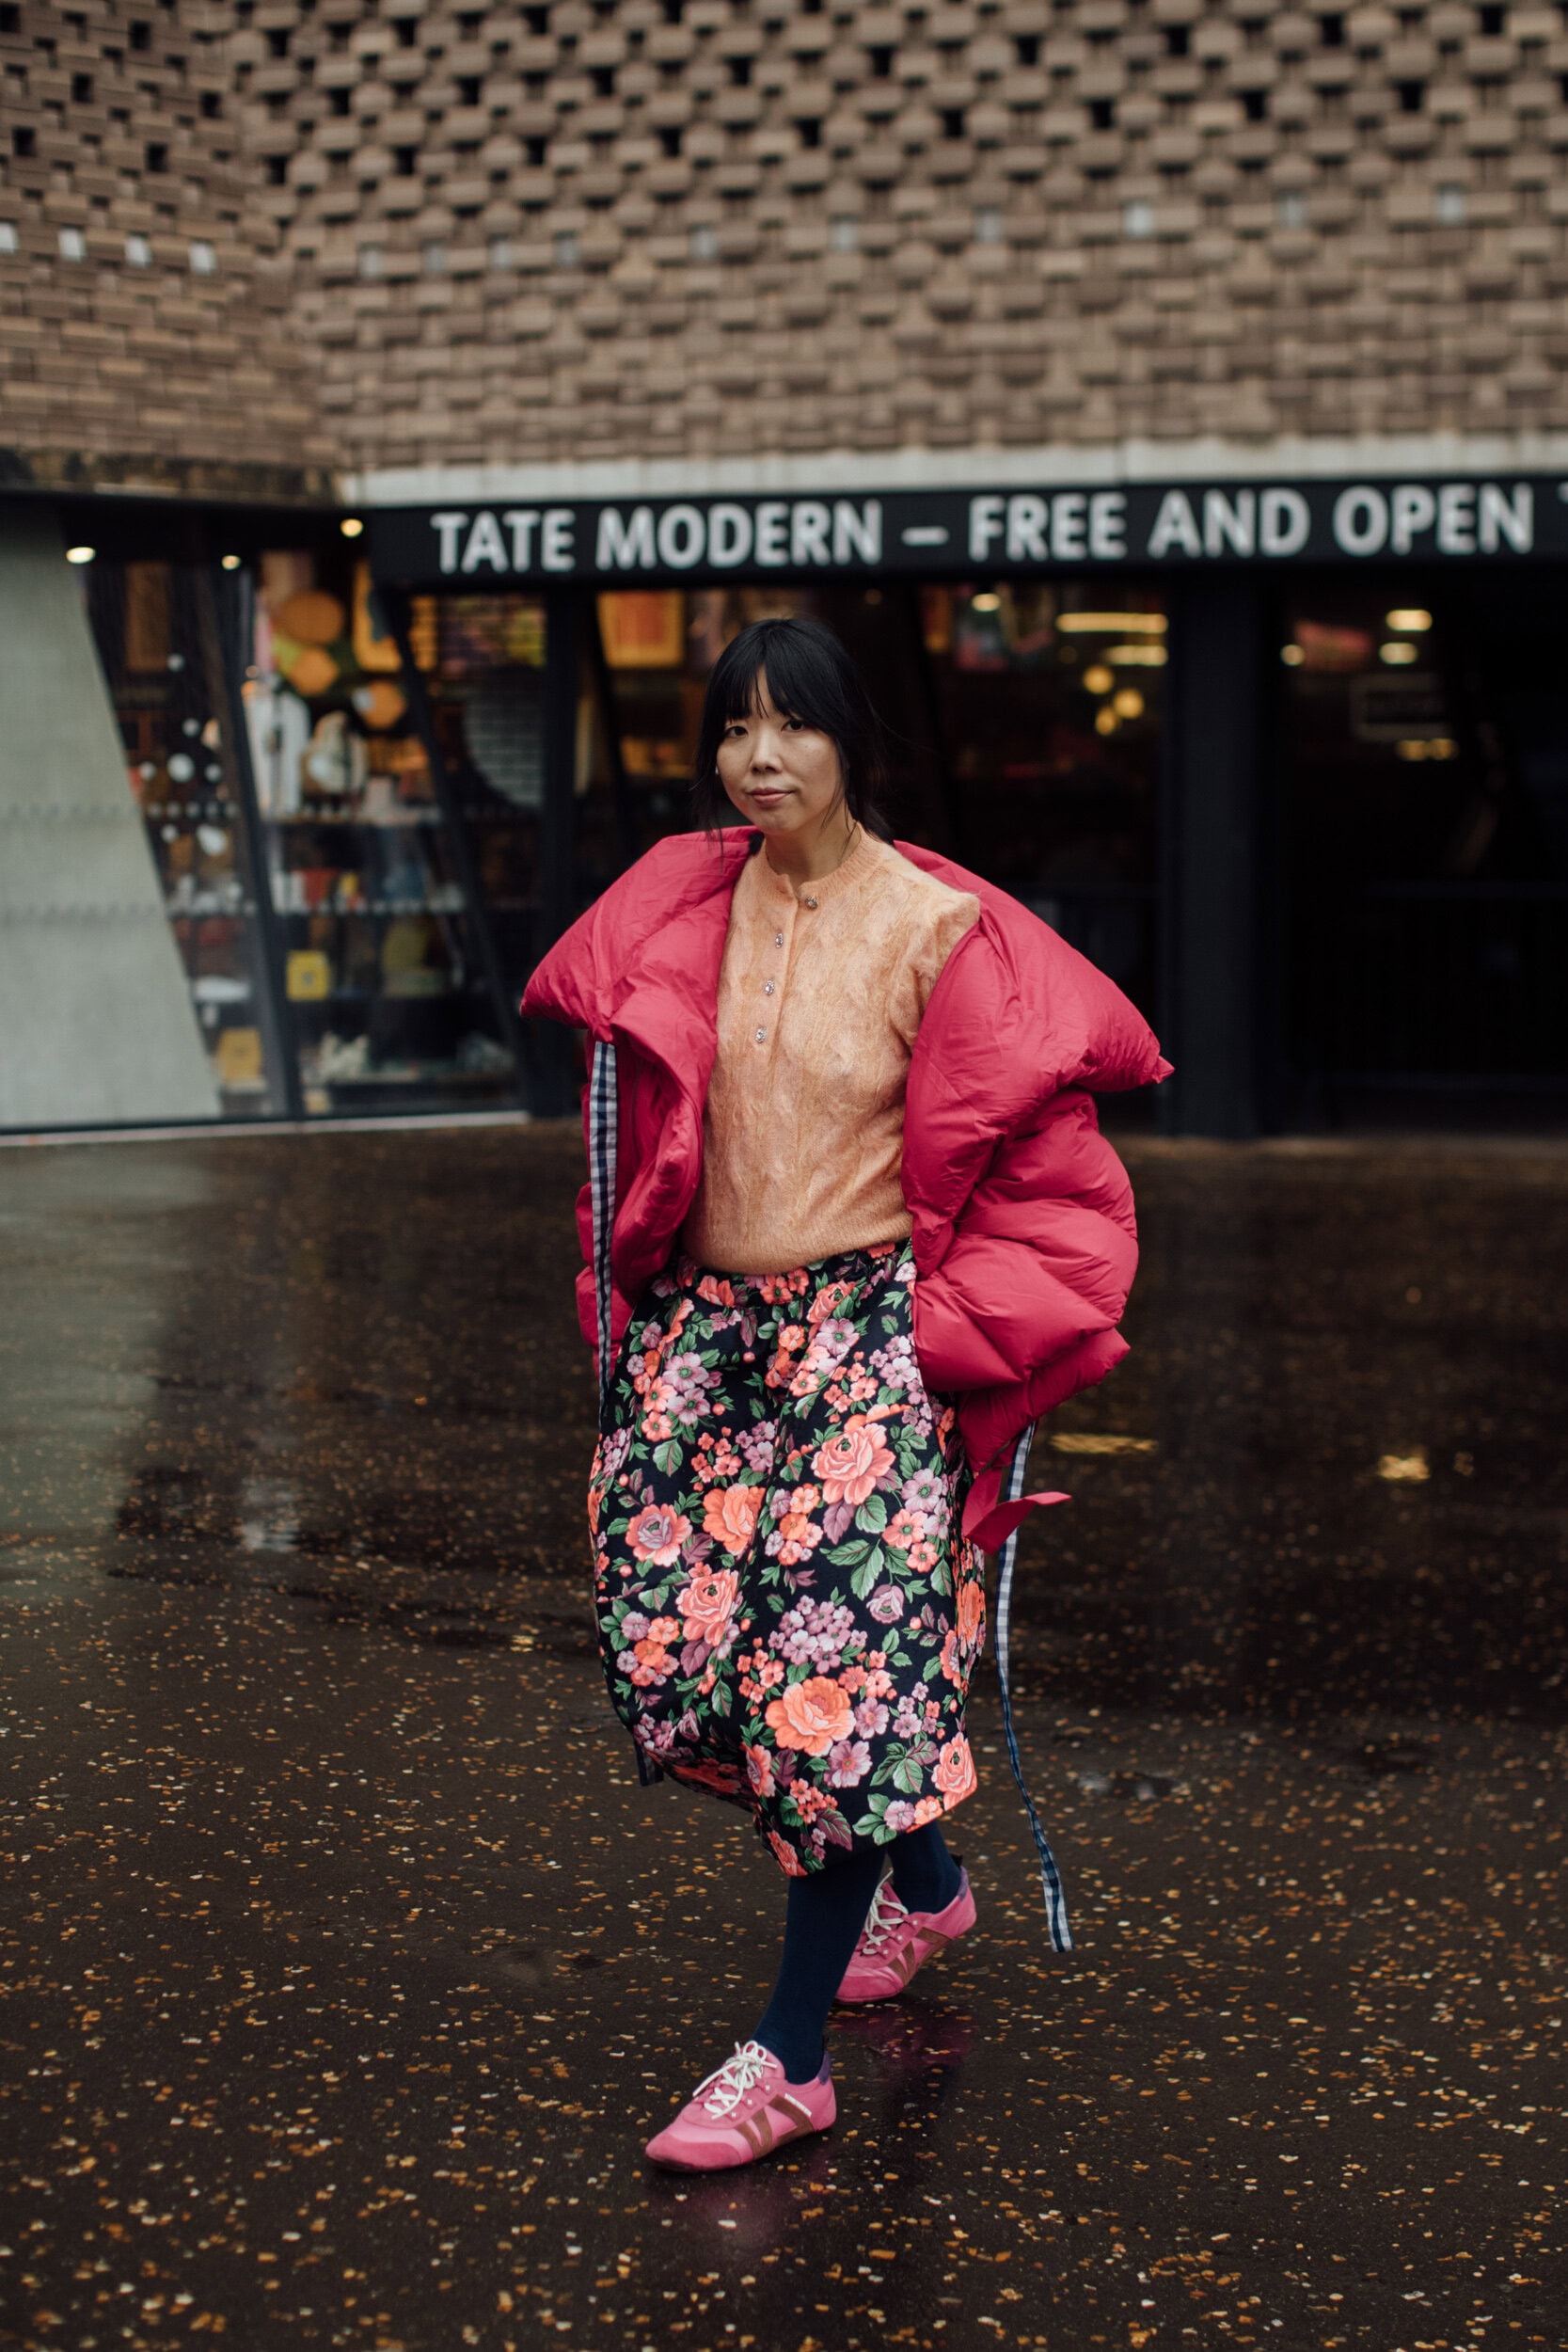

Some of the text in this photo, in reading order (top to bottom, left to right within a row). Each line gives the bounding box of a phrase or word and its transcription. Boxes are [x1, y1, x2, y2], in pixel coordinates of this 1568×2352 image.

[431, 510, 576, 573] TATE
[595, 500, 882, 569] MODERN
[969, 492, 1127, 561] FREE
[1148, 488, 1311, 557] AND
[1332, 484, 1534, 555] OPEN
